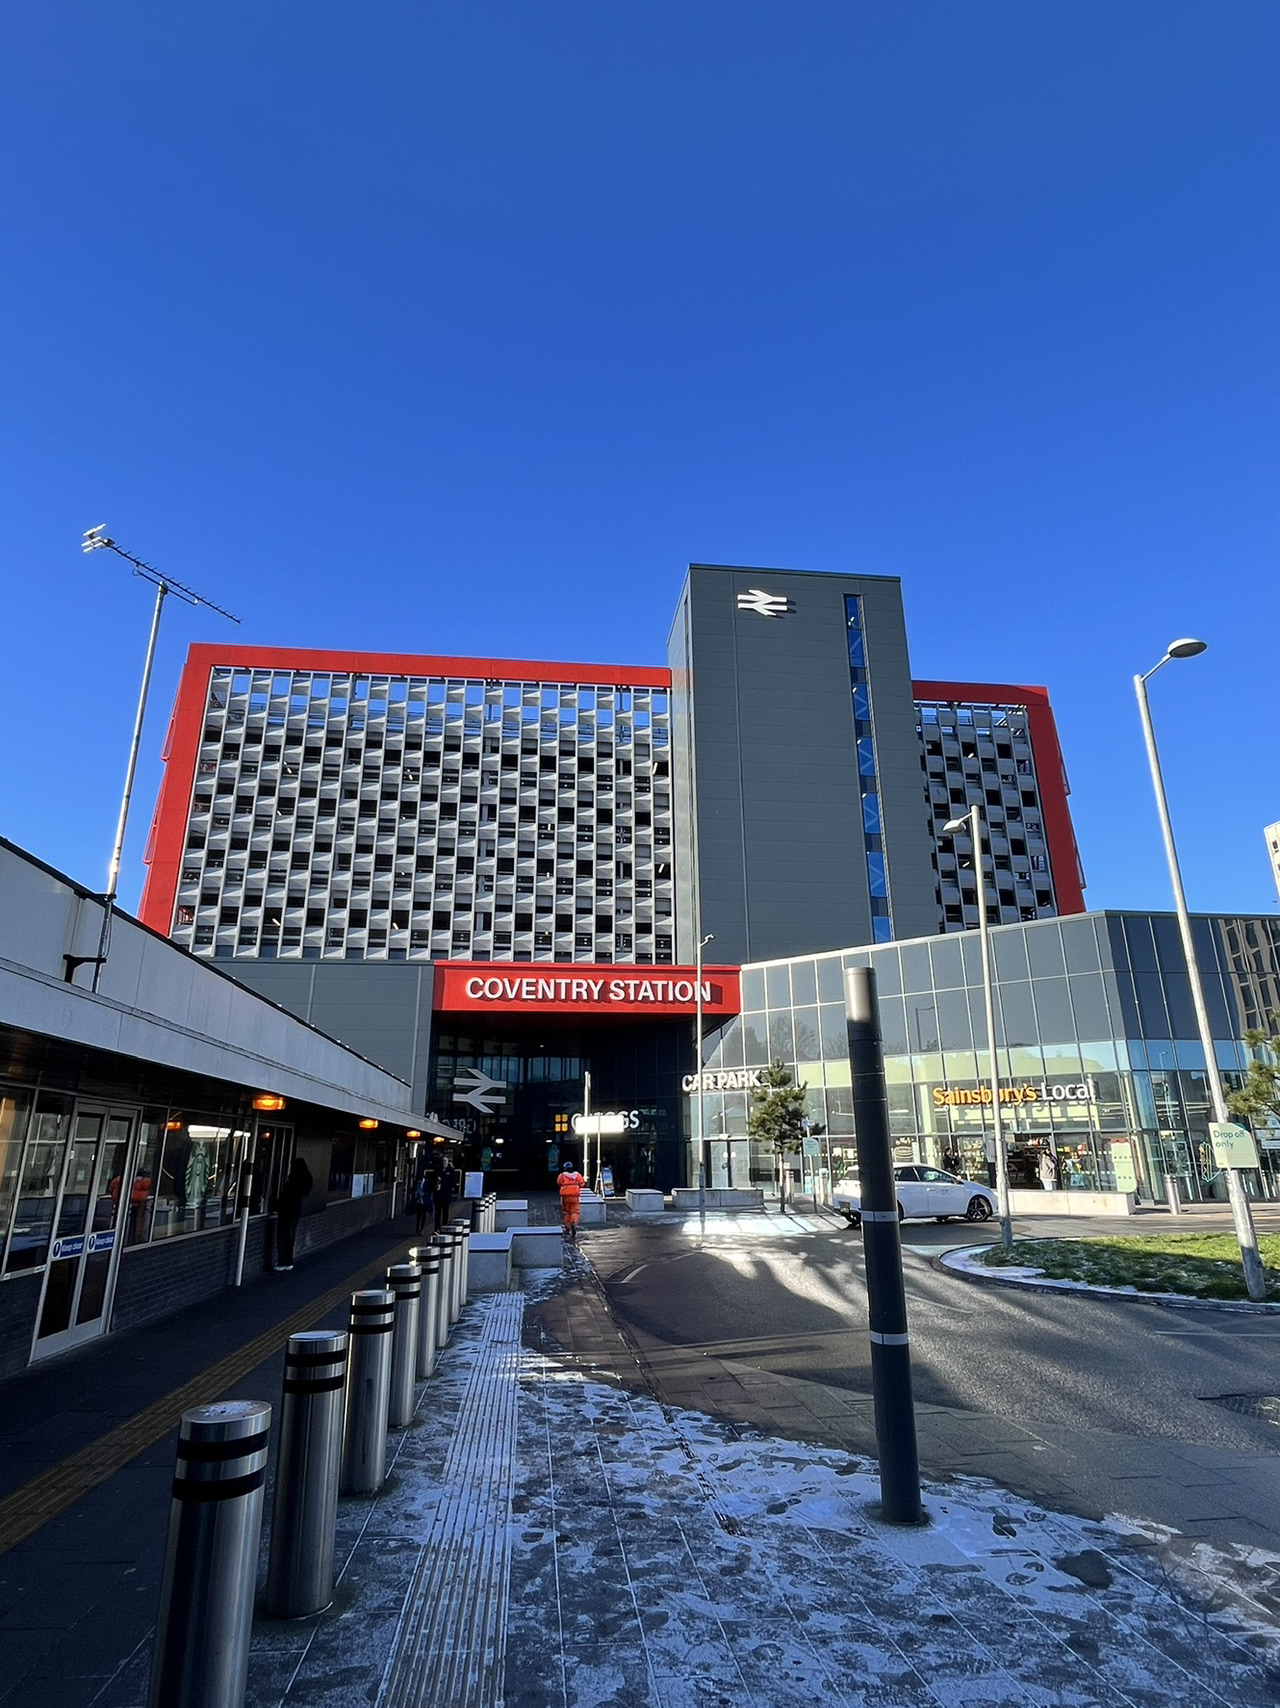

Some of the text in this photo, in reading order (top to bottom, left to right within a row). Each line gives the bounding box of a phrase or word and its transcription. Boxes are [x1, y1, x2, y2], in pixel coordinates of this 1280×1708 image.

[466, 977, 711, 1002] COVENTRY STATION
[681, 1069, 761, 1092] CAR PARK
[1041, 1078, 1096, 1104] Local
[571, 1109, 640, 1131] GGS
[1213, 1130, 1233, 1139] Drop
[1215, 1140, 1234, 1149] only
